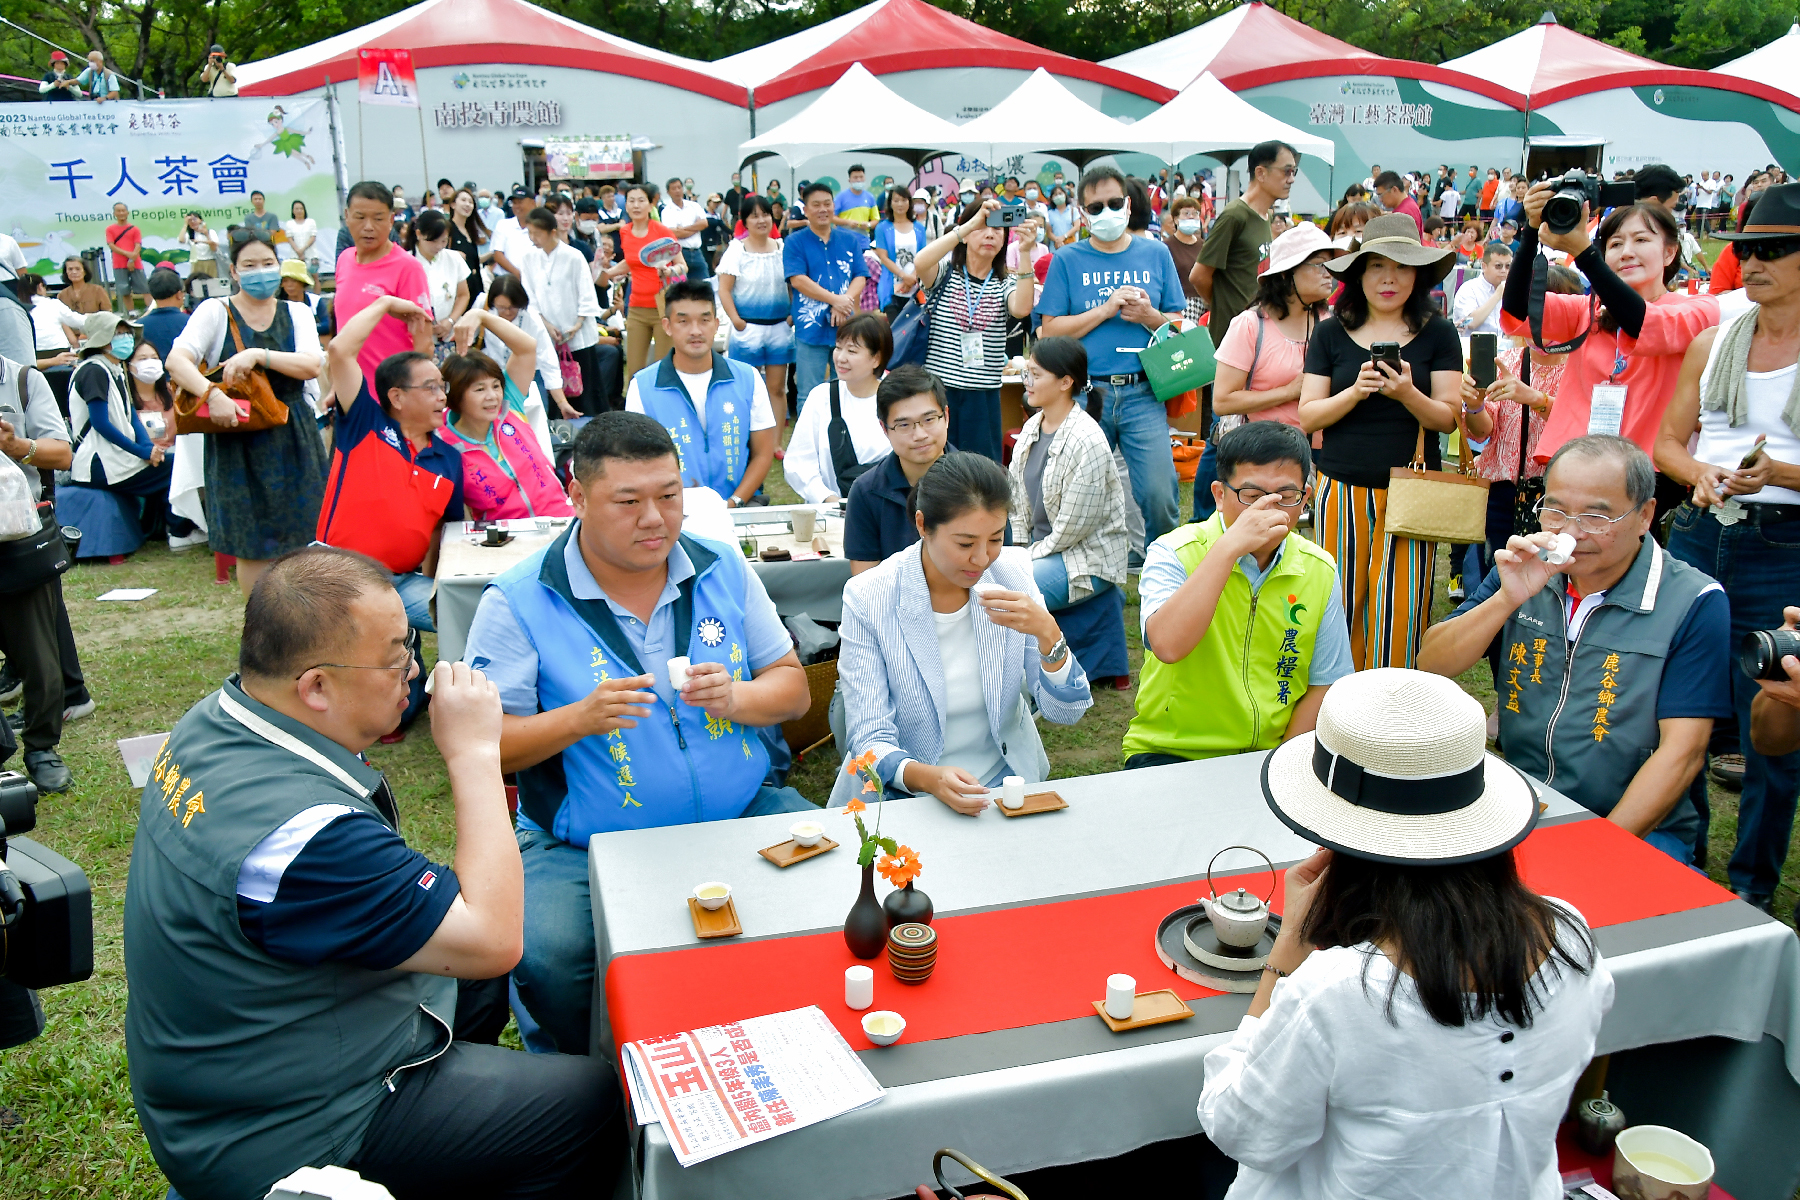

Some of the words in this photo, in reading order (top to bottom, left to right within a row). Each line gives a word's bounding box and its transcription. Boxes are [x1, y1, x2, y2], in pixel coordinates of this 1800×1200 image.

[0, 114, 26, 123] 2023
[28, 114, 56, 122] Nantou
[57, 113, 82, 121] Global
[83, 113, 96, 121] Tea
[97, 113, 116, 121] Expo
[434, 100, 561, 127] 南投青農館
[49, 154, 250, 199] 千人茶會
[131, 208, 176, 221] People
[180, 207, 232, 219] Bwing
[1082, 270, 1150, 286] BUFFALO
[1274, 627, 1301, 705] 農糧署
[1506, 642, 1528, 713] 陳文益
[1530, 638, 1548, 684] 理事長
[1591, 652, 1620, 742] 鹿谷鄉農會
